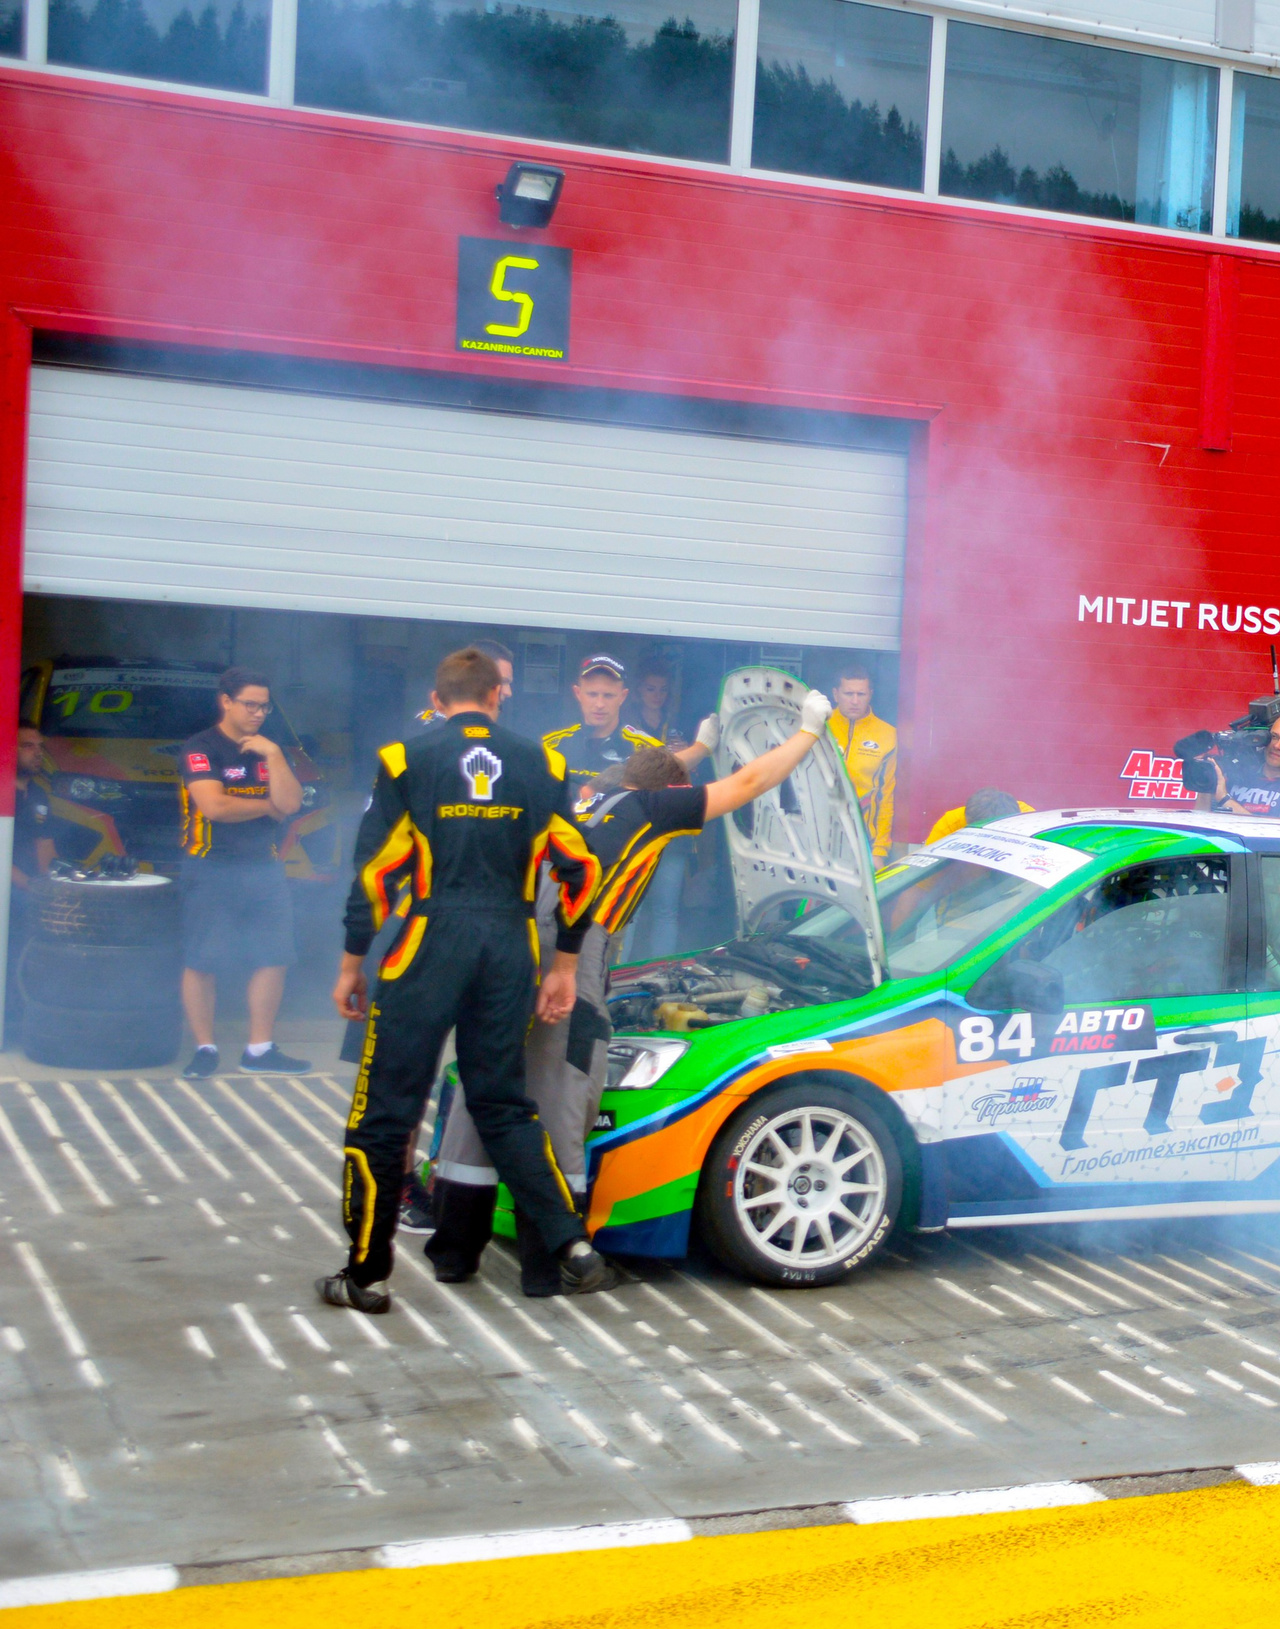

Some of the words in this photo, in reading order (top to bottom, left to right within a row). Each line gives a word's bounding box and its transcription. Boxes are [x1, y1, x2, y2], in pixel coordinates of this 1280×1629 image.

[485, 255, 540, 338] 5
[461, 339, 522, 355] KAZANRING
[522, 346, 563, 359] CANYON
[1078, 594, 1191, 629] MITJET
[52, 689, 134, 717] 10
[439, 804, 525, 820] ROSNEFT
[962, 843, 1013, 862] RACING
[959, 1012, 1036, 1062] 84
[1055, 1007, 1145, 1035] АВТО
[1050, 1034, 1117, 1053] ПЛЮС
[347, 1001, 381, 1130] ROSNEFT
[732, 1115, 768, 1156] YOKOHAMA
[1060, 1126, 1259, 1176] Глобалтехэкспорт
[844, 1213, 890, 1269] ADVAN
